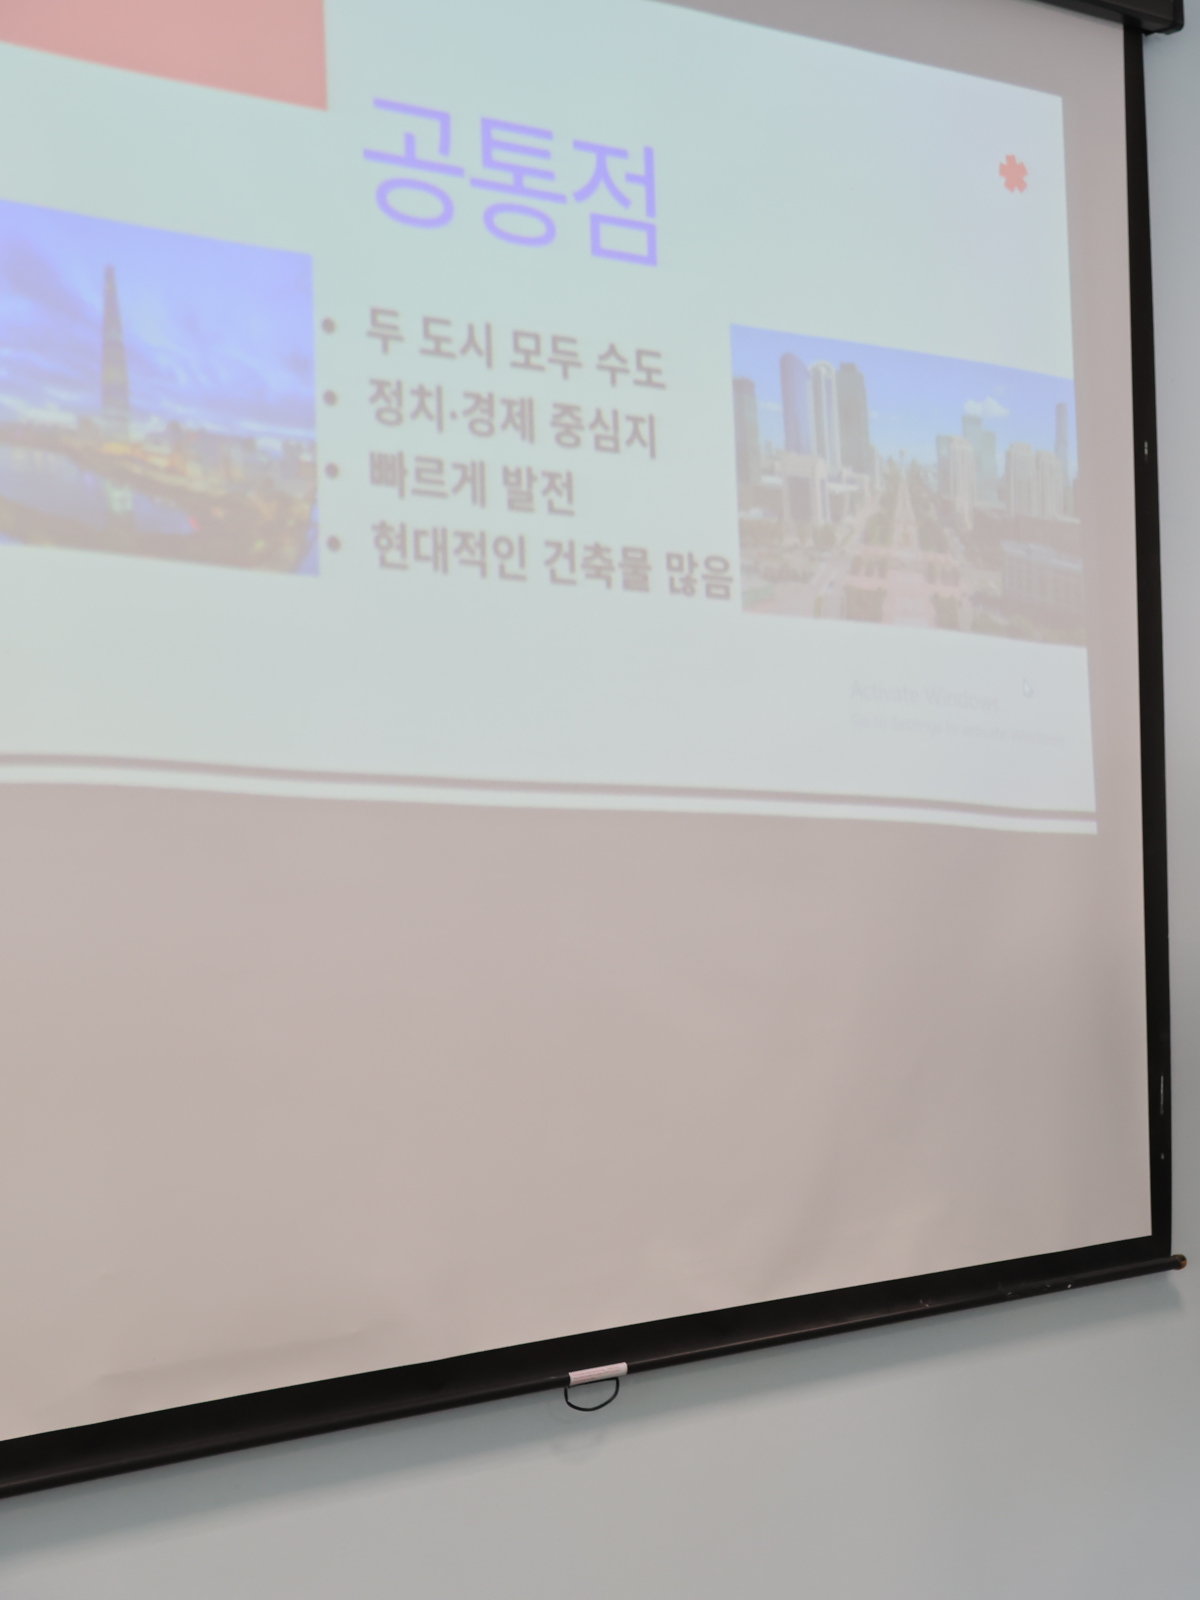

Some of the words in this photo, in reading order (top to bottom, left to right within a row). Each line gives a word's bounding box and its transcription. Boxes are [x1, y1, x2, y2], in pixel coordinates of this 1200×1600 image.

[363, 96, 658, 267] 공통점
[366, 306, 405, 356] 두
[419, 316, 494, 371] 도시
[509, 329, 583, 381] 모두
[596, 342, 667, 390] 수도
[368, 377, 536, 445] 정치·경제
[550, 401, 657, 460] 중심지
[369, 450, 488, 509] 빠르게
[502, 464, 576, 517] 발전
[371, 520, 528, 582] 현대적인
[543, 539, 653, 593] 건축물
[665, 551, 734, 601] 많음
